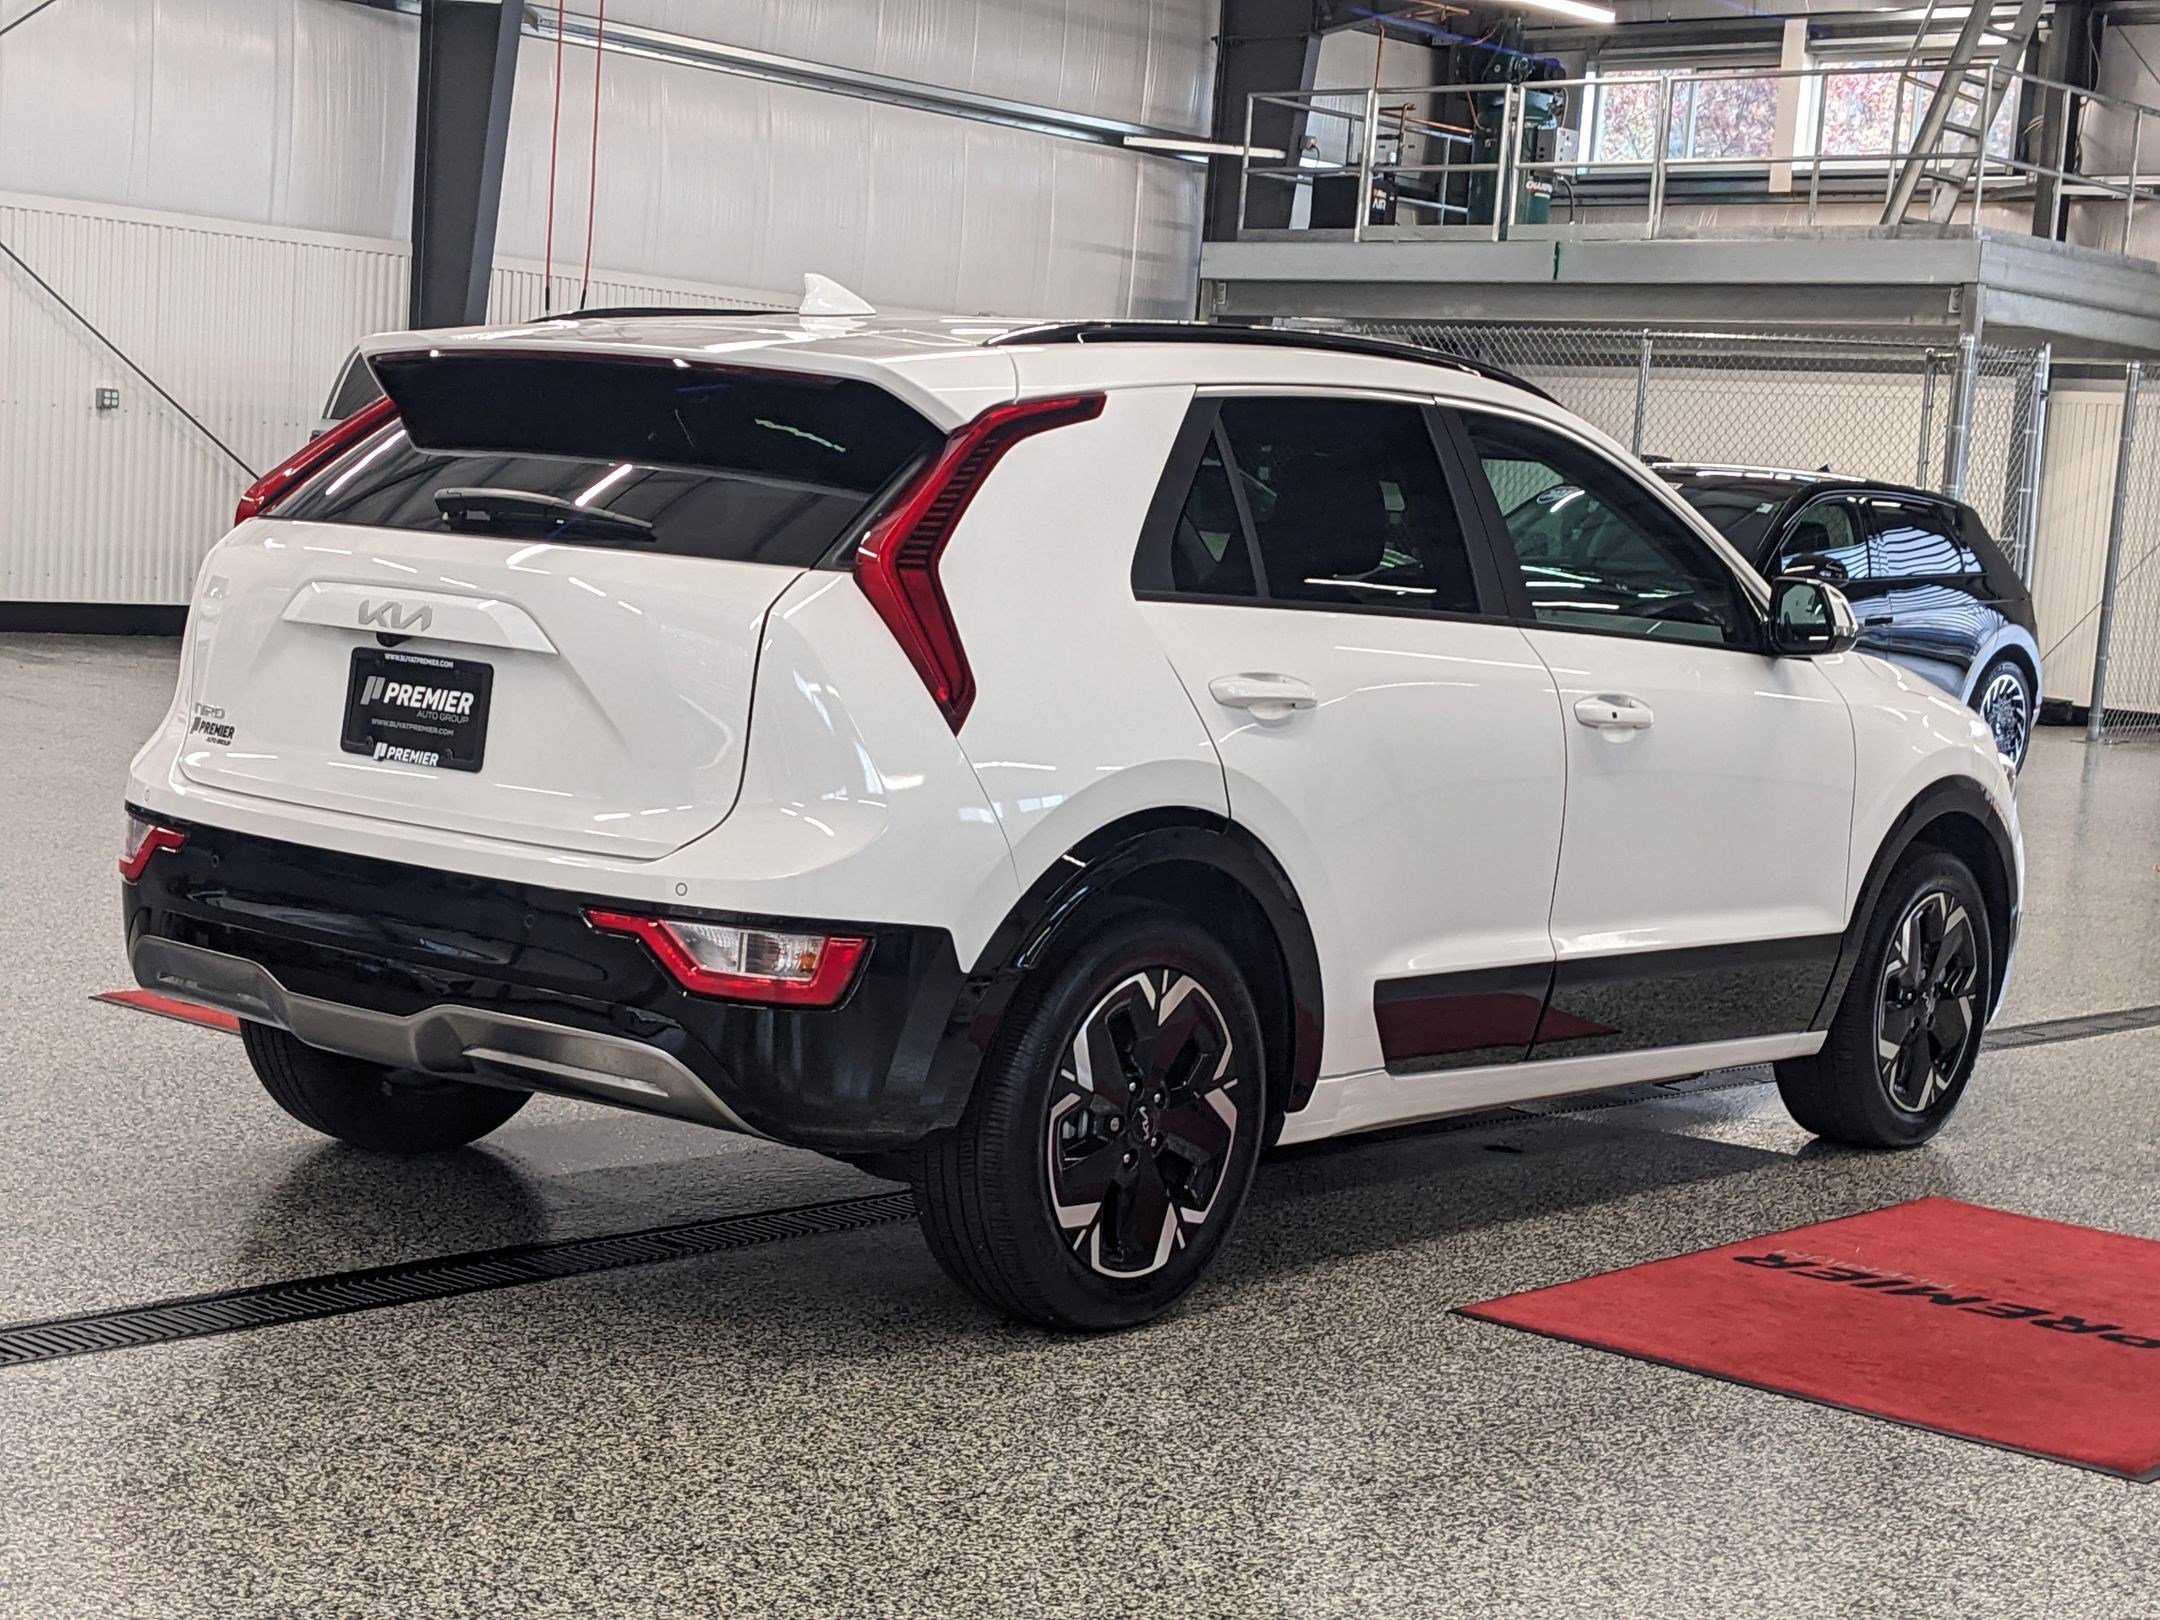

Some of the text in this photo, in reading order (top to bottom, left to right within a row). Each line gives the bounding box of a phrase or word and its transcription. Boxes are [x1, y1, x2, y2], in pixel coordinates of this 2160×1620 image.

[358, 599, 433, 632] KIA
[383, 682, 475, 715] PREMIER
[371, 718, 455, 736] WWW.BUYATPREMIER.COM
[416, 711, 470, 724] AUTO GROUP
[198, 720, 236, 740] PREMIER
[386, 748, 439, 767] PREMIER
